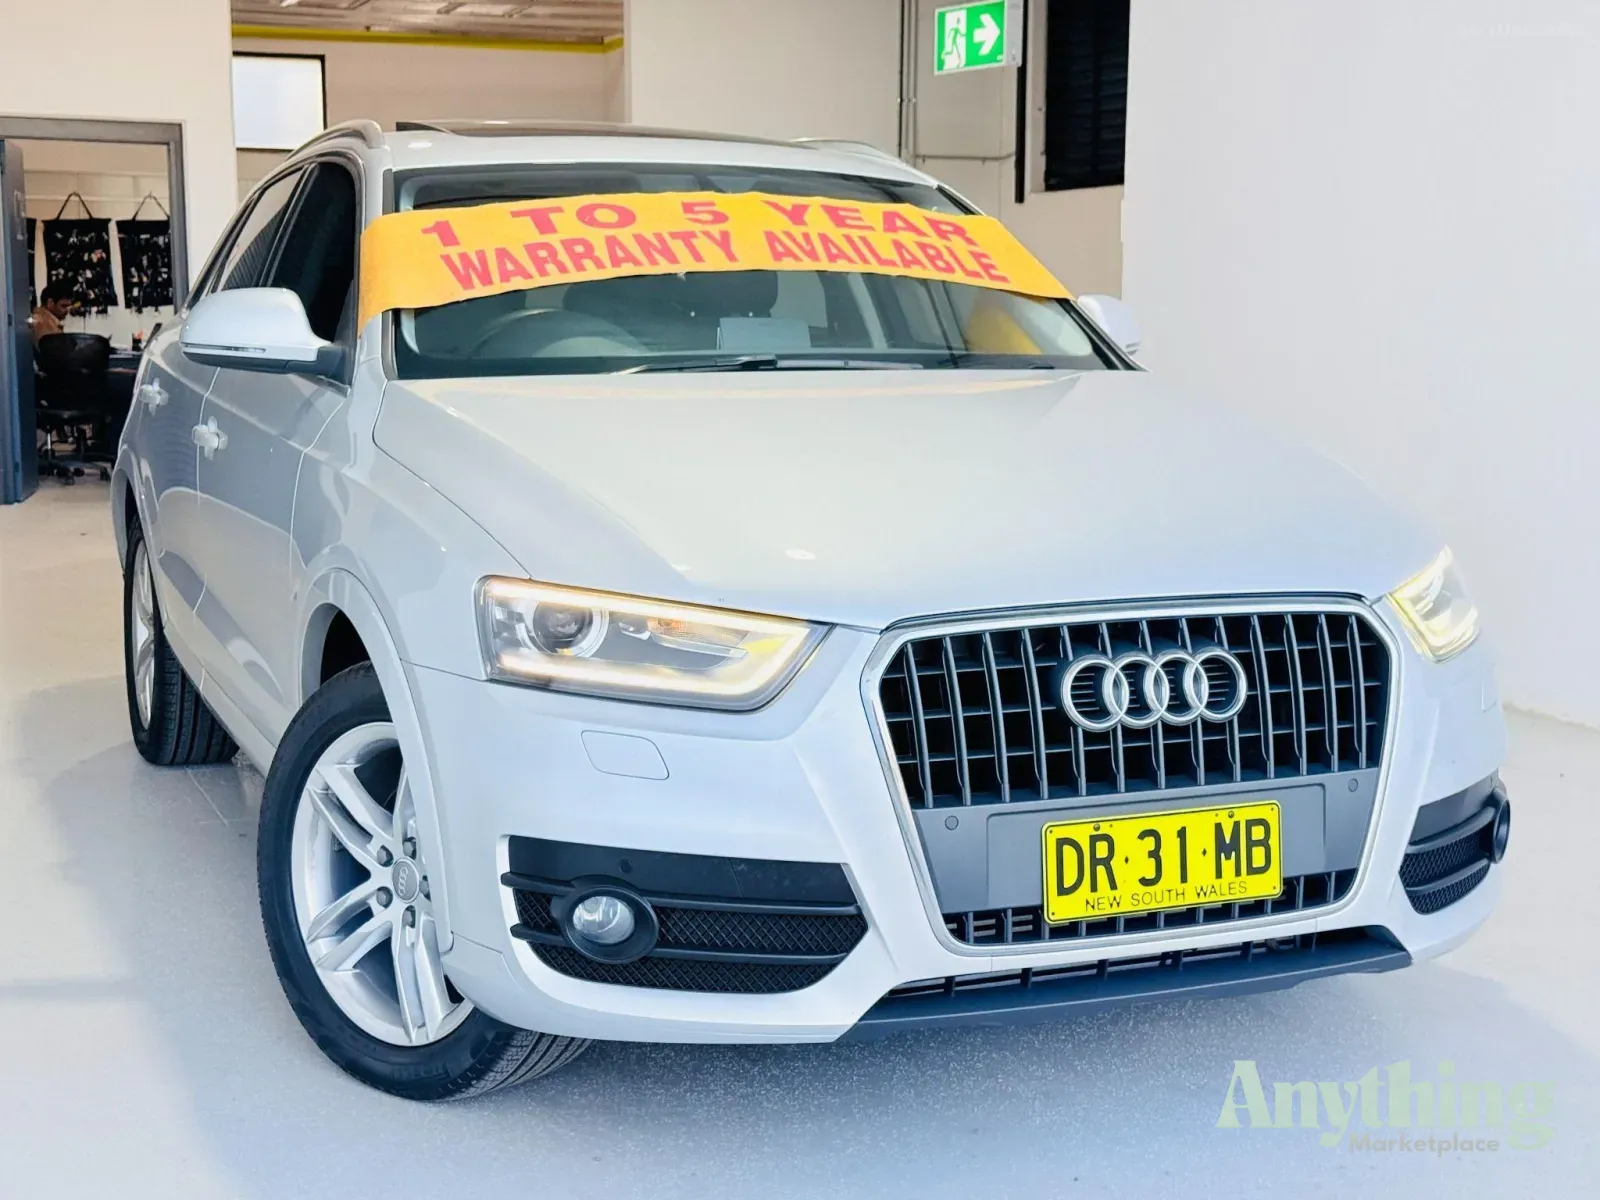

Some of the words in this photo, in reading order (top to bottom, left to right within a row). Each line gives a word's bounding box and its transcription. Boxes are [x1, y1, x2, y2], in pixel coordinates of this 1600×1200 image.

[421, 220, 461, 247] 1
[510, 203, 637, 235] TO
[681, 201, 729, 225] 5
[762, 199, 979, 247] YEAR
[440, 230, 740, 290] WARRANTY
[763, 230, 1010, 284] AVAILABLE
[1085, 894, 1122, 912] NEW
[1131, 887, 1186, 907] SOUTH
[1194, 880, 1248, 900] WALES
